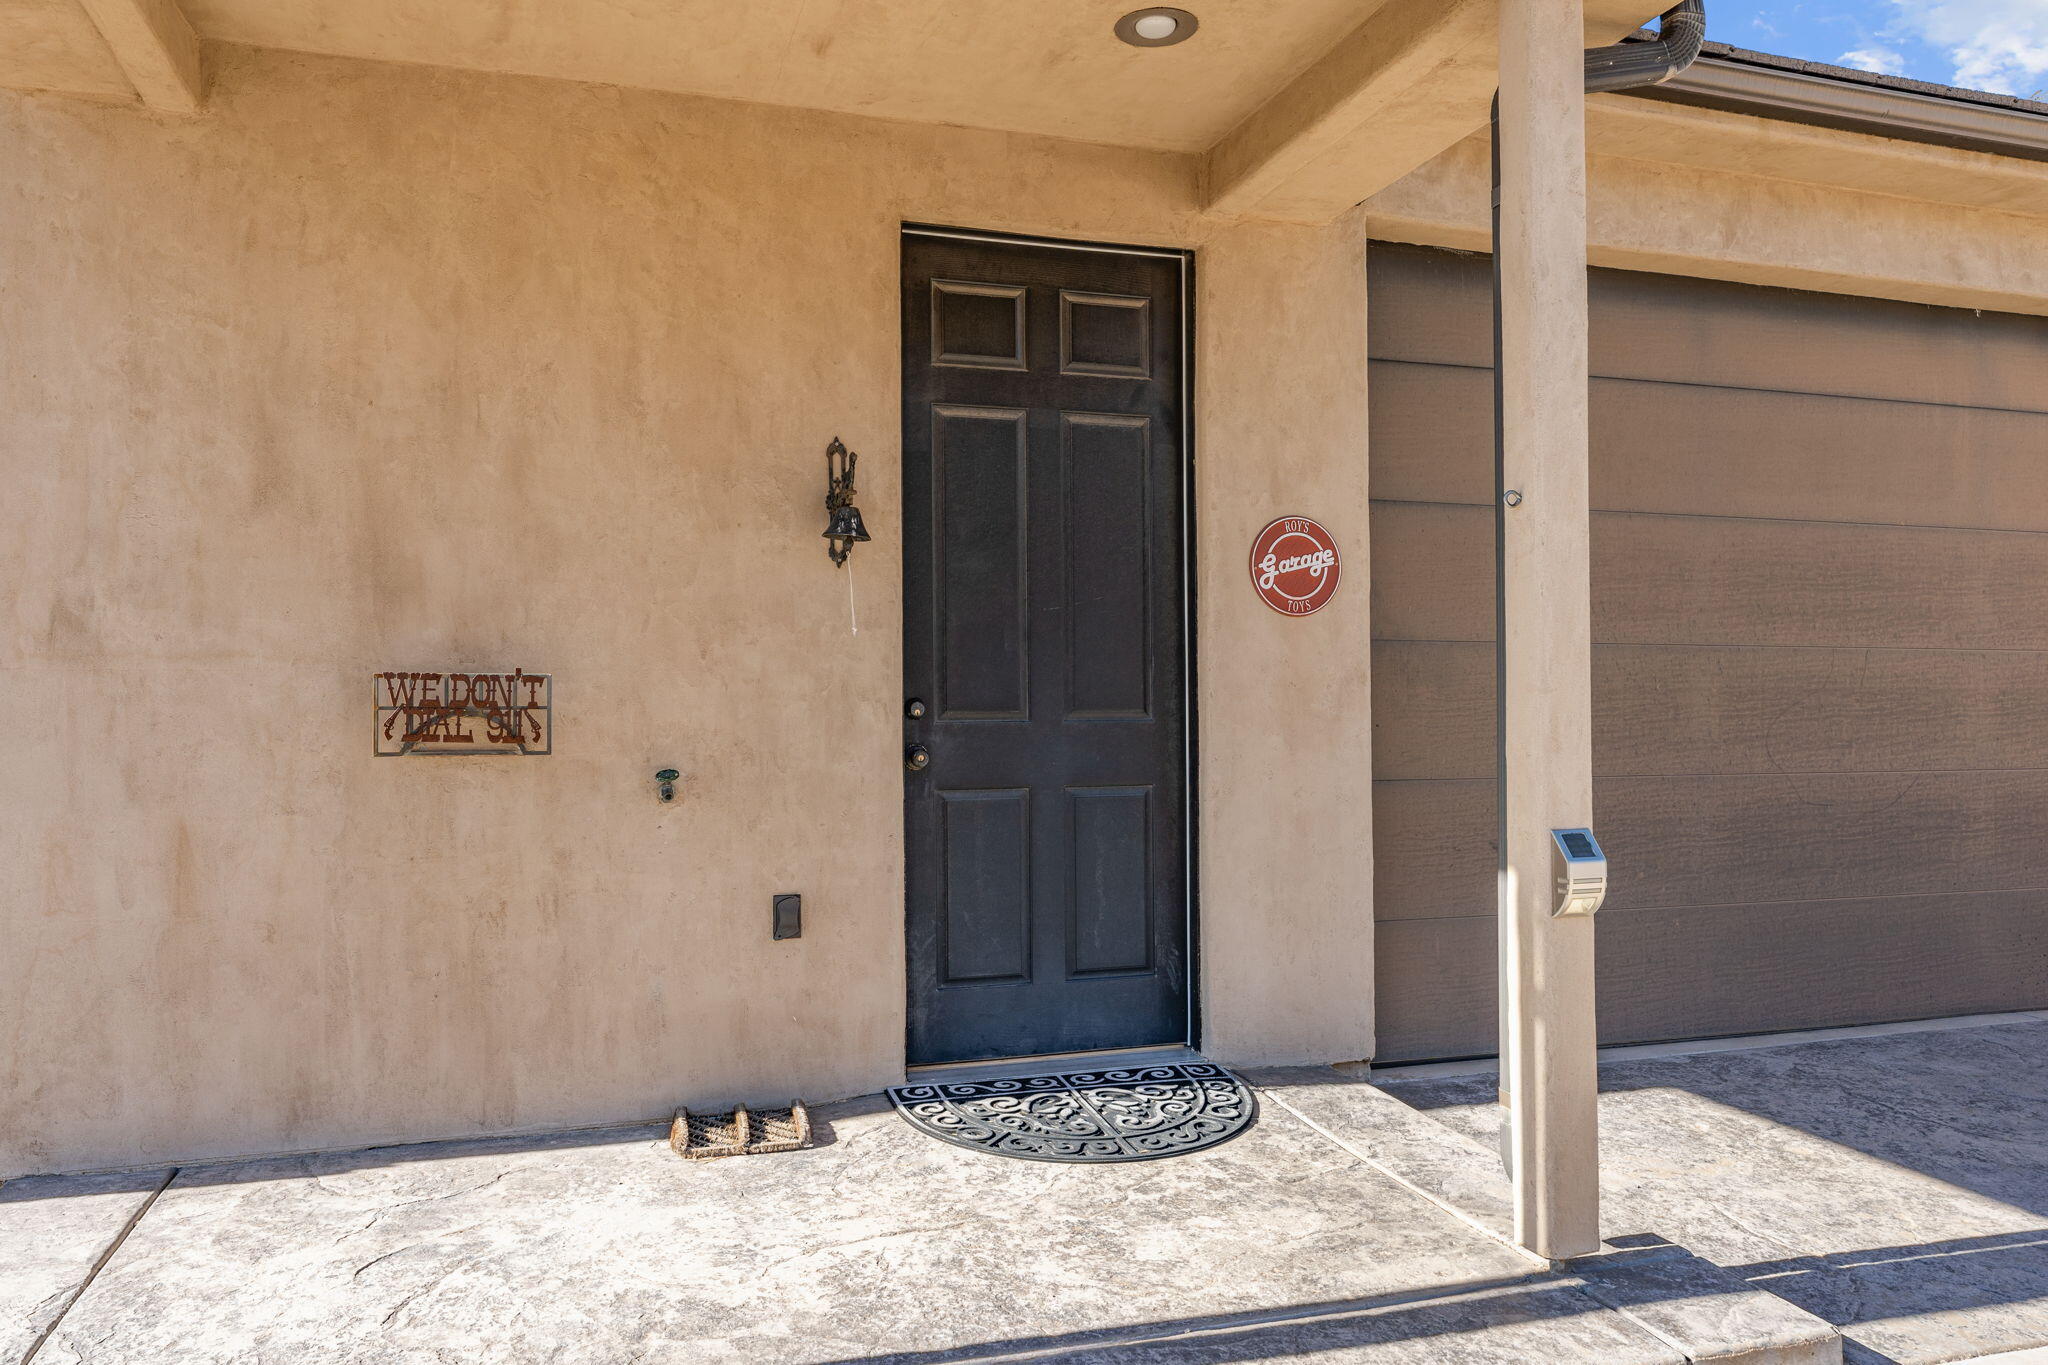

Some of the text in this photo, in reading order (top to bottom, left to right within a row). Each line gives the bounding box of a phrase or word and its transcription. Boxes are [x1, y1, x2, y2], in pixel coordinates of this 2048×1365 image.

[1285, 520, 1309, 533] ROY'S
[1259, 549, 1334, 589] Garage
[1287, 600, 1311, 612] TOYS
[383, 668, 545, 709] WE DON'T
[401, 707, 525, 743] DIAL 911
